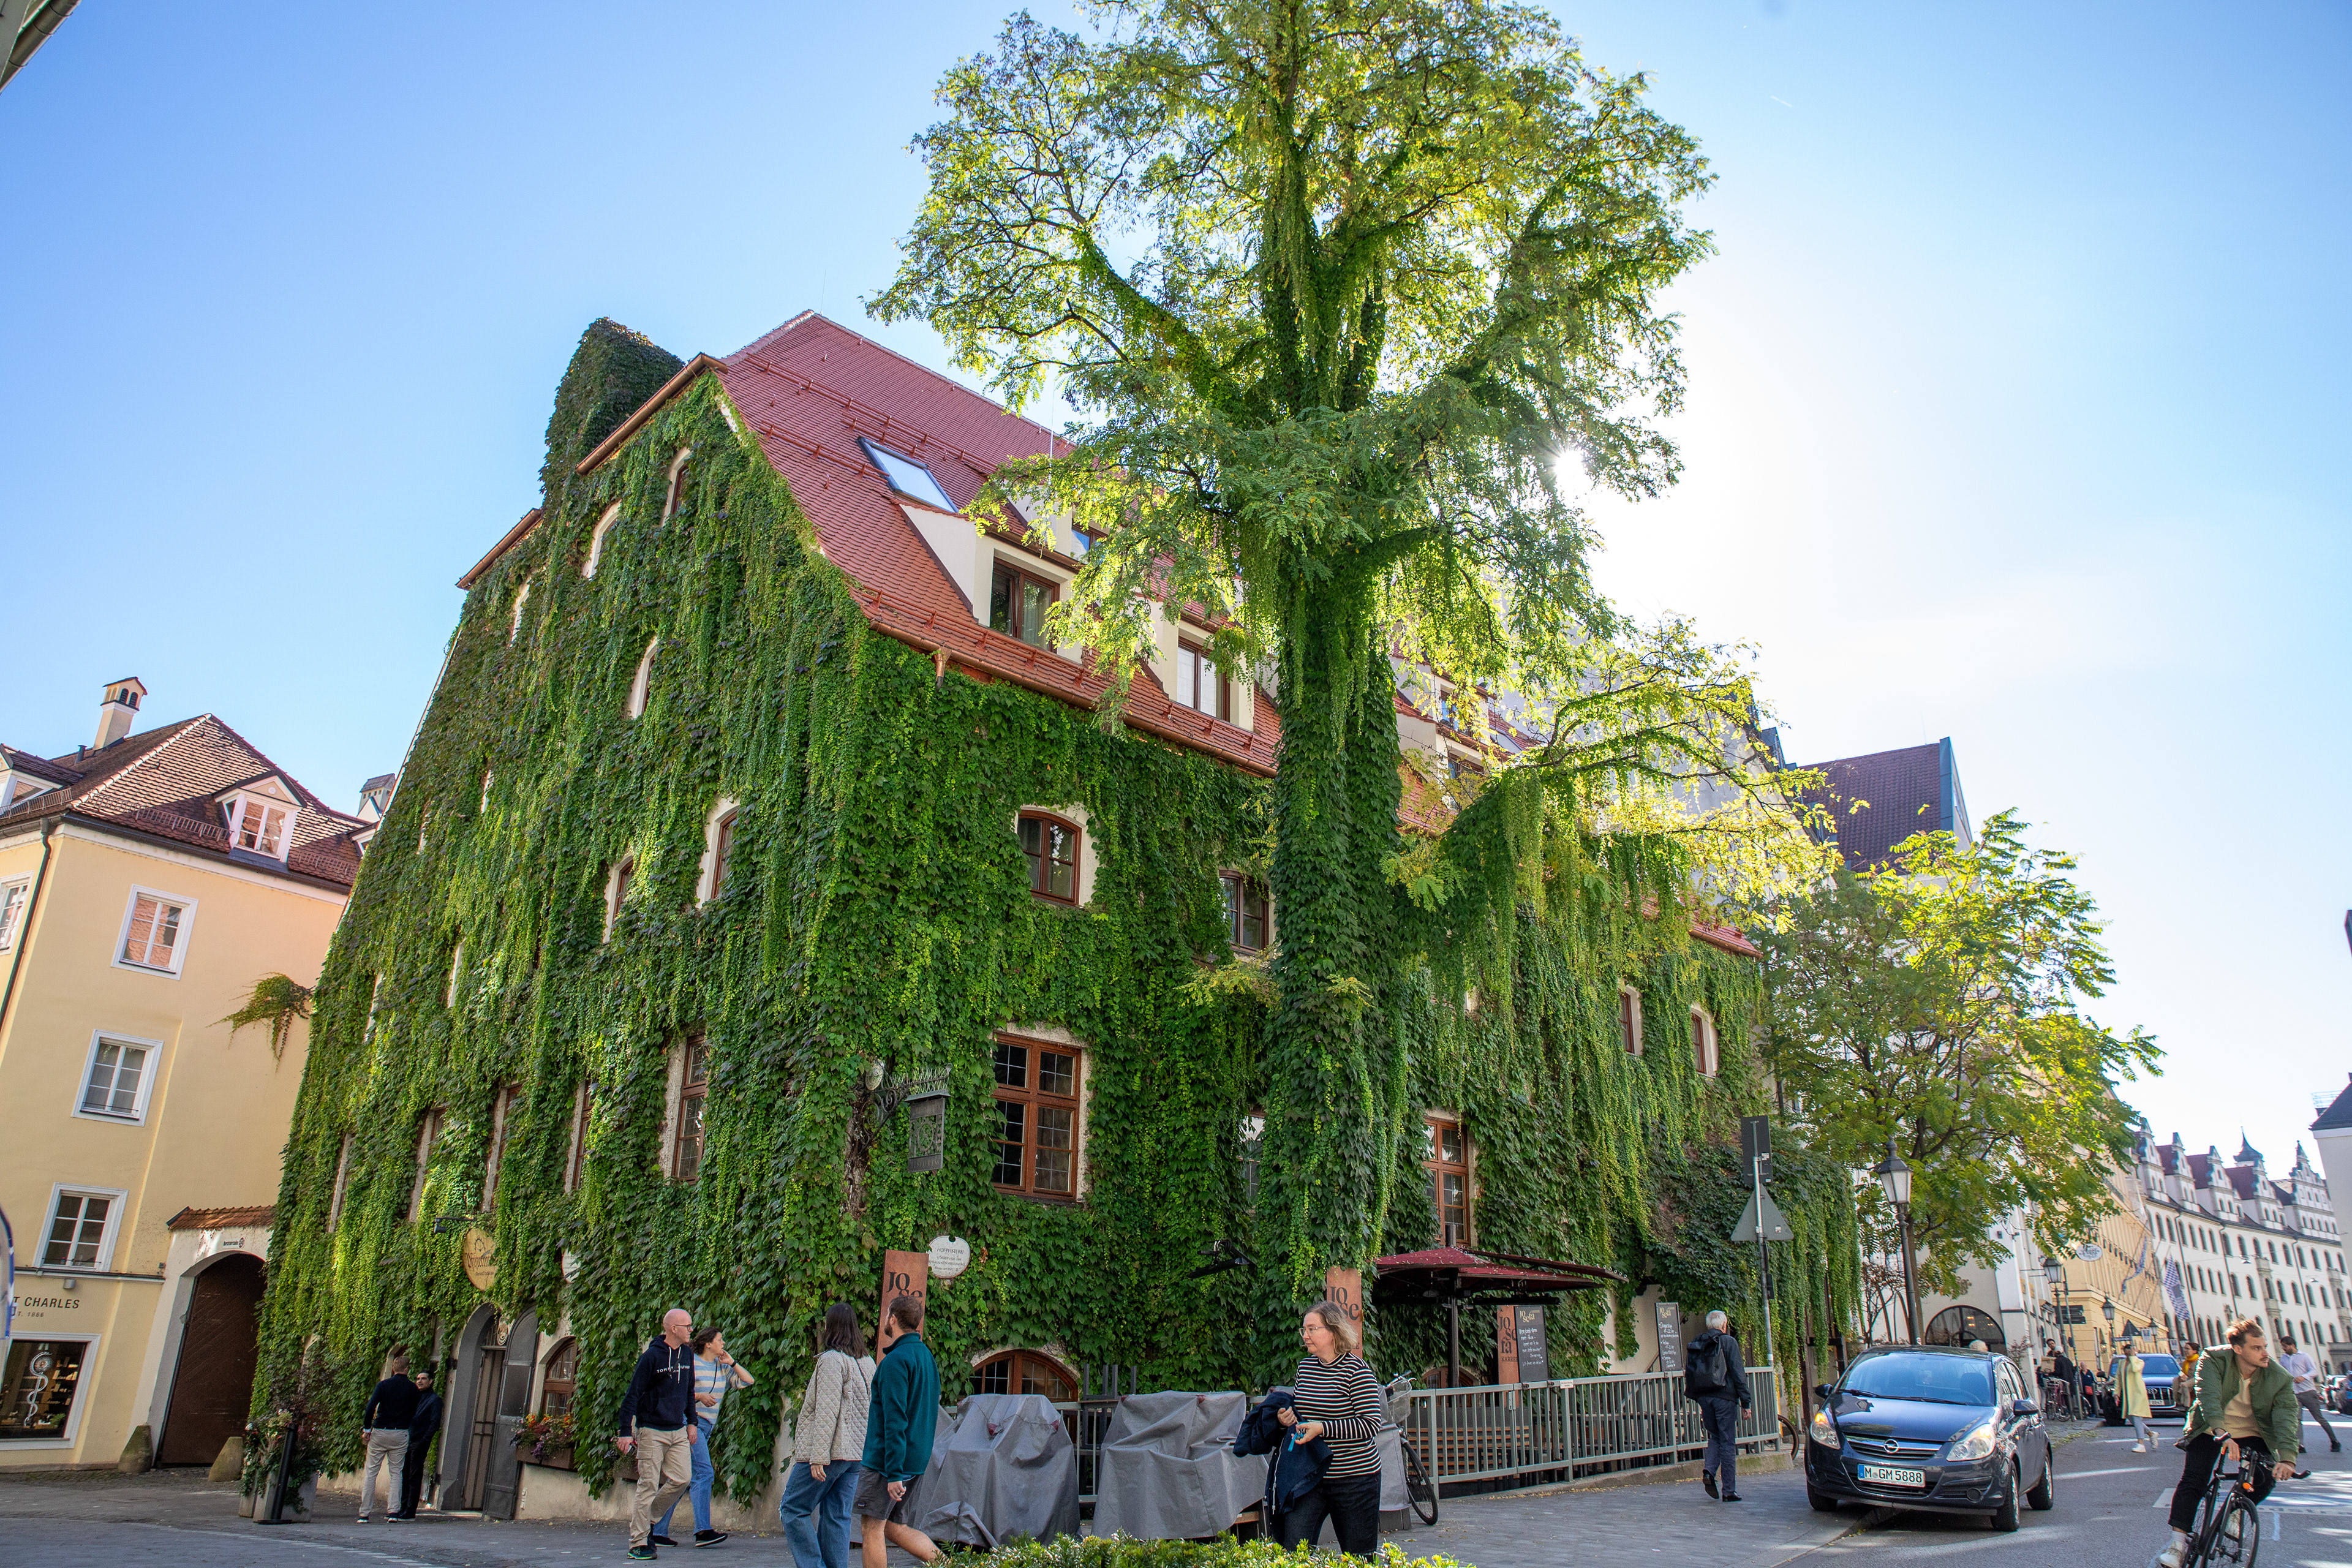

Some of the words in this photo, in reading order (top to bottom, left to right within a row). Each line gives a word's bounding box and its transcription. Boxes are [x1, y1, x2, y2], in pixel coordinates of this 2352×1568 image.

[24, 1297, 80, 1309] CHARLES
[1864, 1467, 1872, 1477] M
[1879, 1469, 1893, 1480] GM
[1895, 1470, 1922, 1483] 5888
